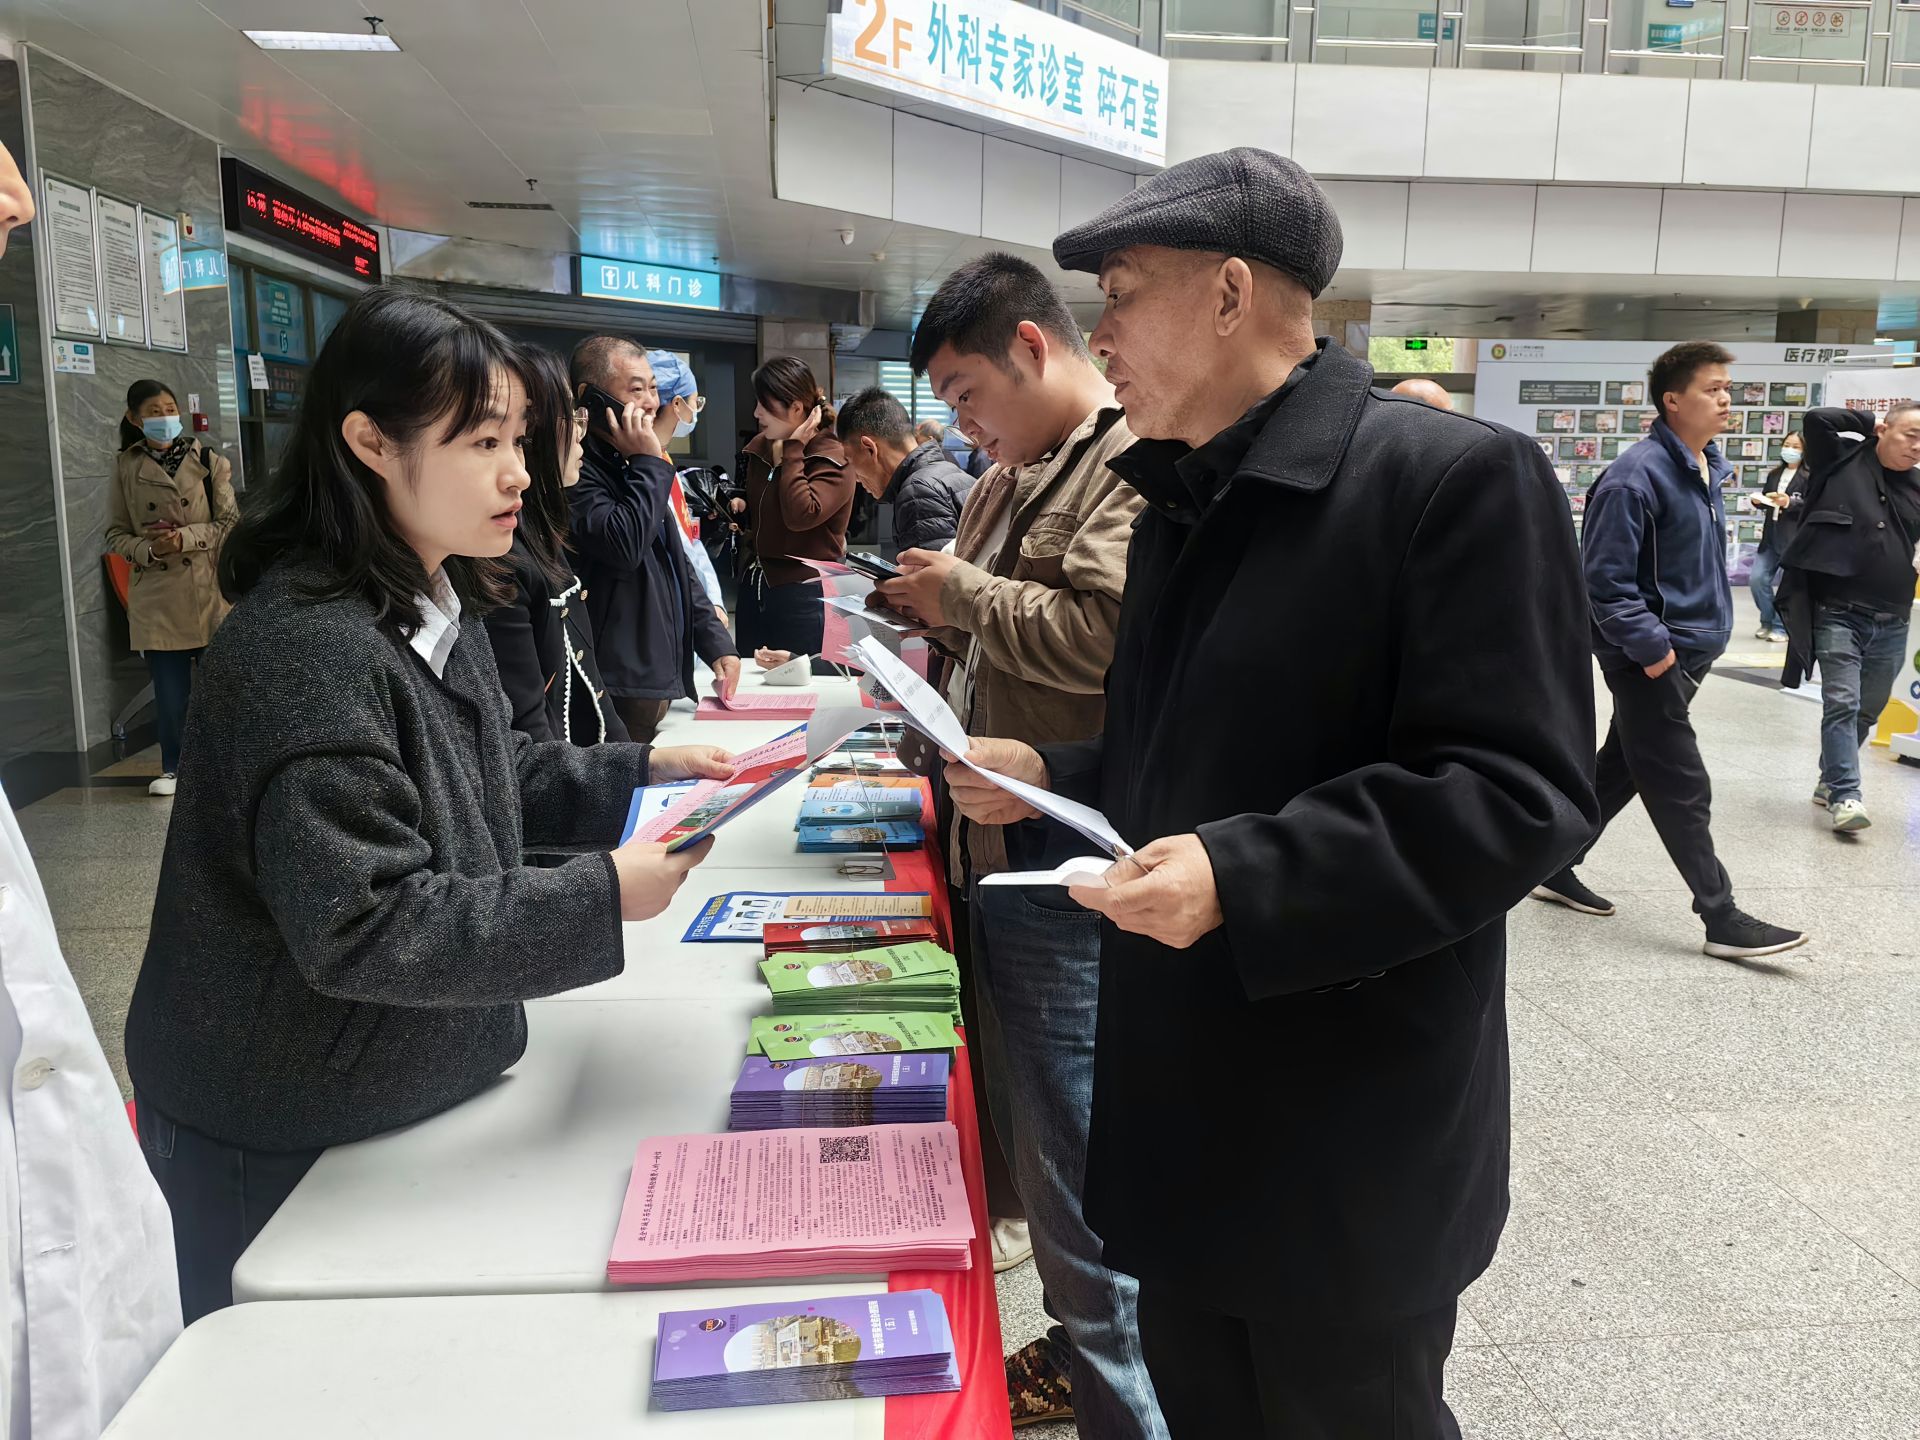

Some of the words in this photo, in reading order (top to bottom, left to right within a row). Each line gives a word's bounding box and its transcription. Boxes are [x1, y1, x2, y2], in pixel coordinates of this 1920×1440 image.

[855, 0, 913, 69] 2F
[928, 1, 1084, 115] 外科专家诊室
[1097, 65, 1160, 139] 碎石室
[624, 270, 703, 298] 儿科门诊
